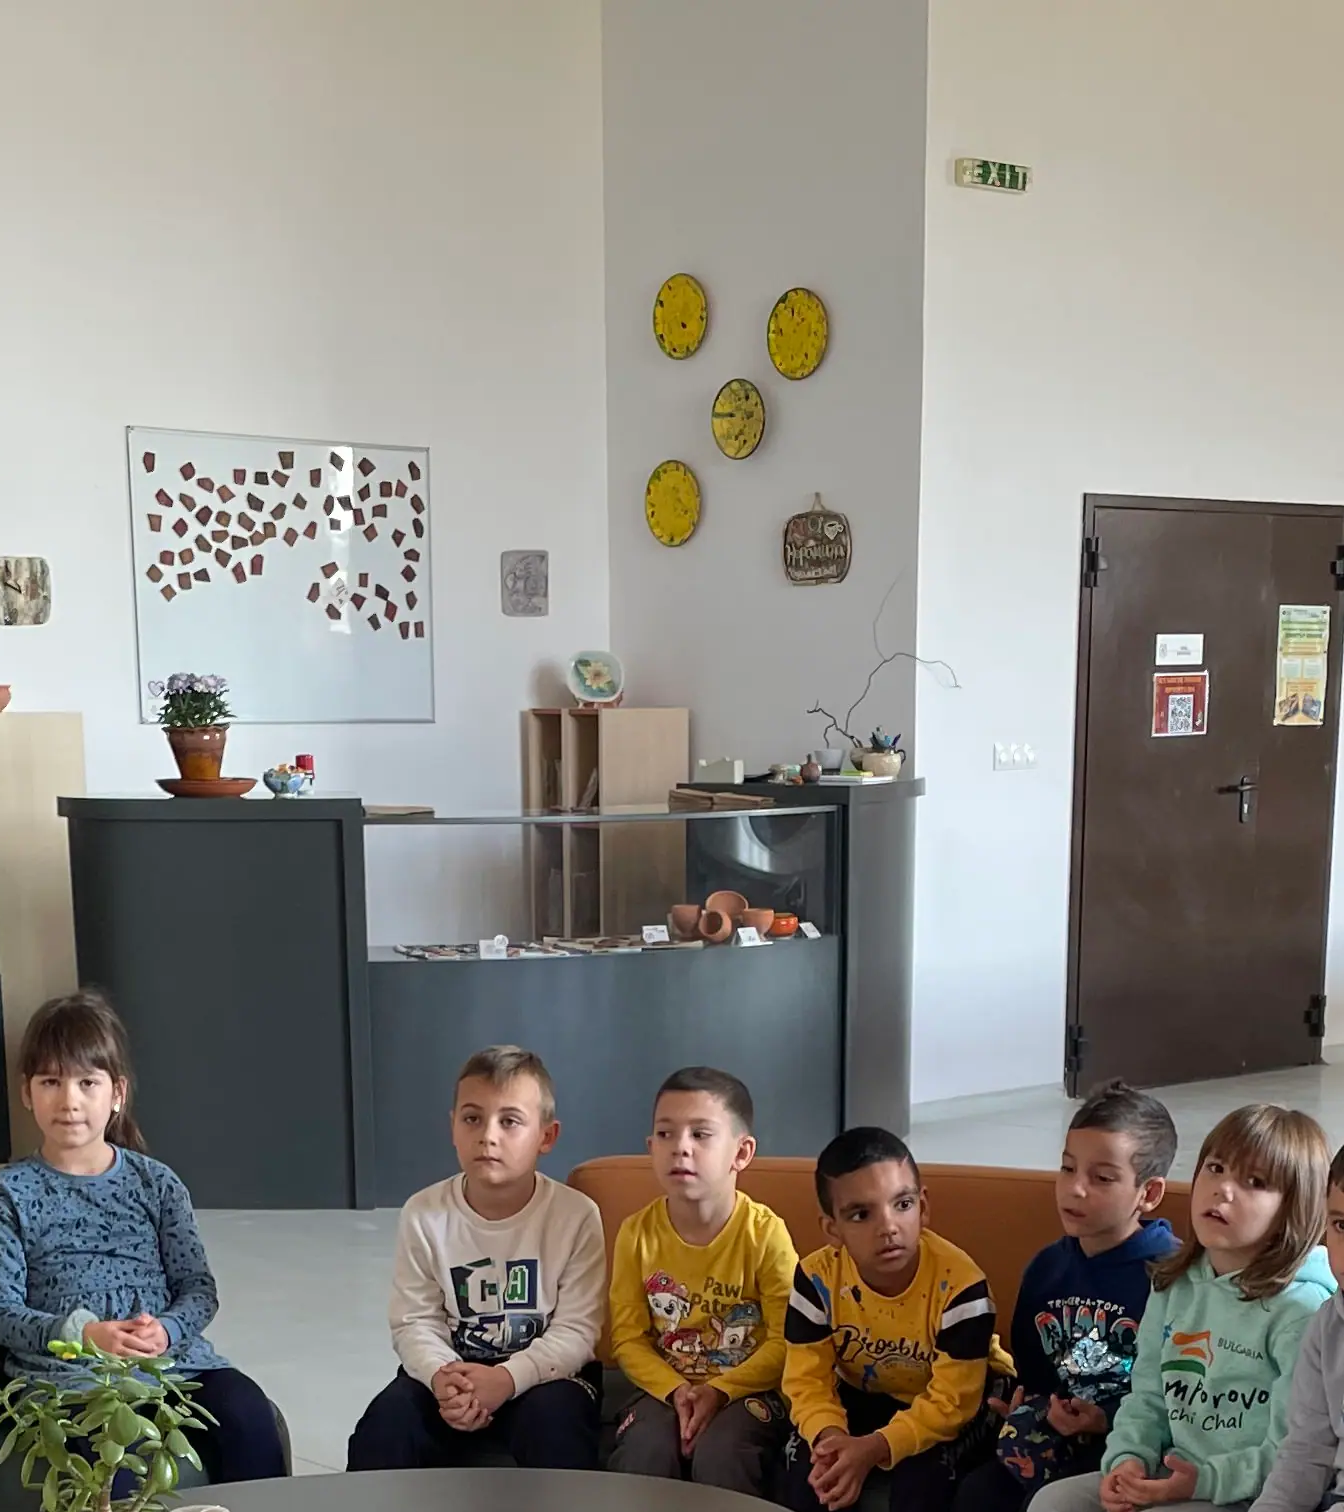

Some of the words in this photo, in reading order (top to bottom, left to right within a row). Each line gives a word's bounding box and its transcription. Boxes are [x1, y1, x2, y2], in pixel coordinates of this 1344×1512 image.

[971, 159, 1027, 190] EXIT
[703, 1276, 741, 1298] Paw
[690, 1292, 730, 1315] Patr
[1216, 1337, 1265, 1361] BULGARIA
[1169, 1408, 1197, 1424] chi
[1201, 1411, 1244, 1431] Chal
